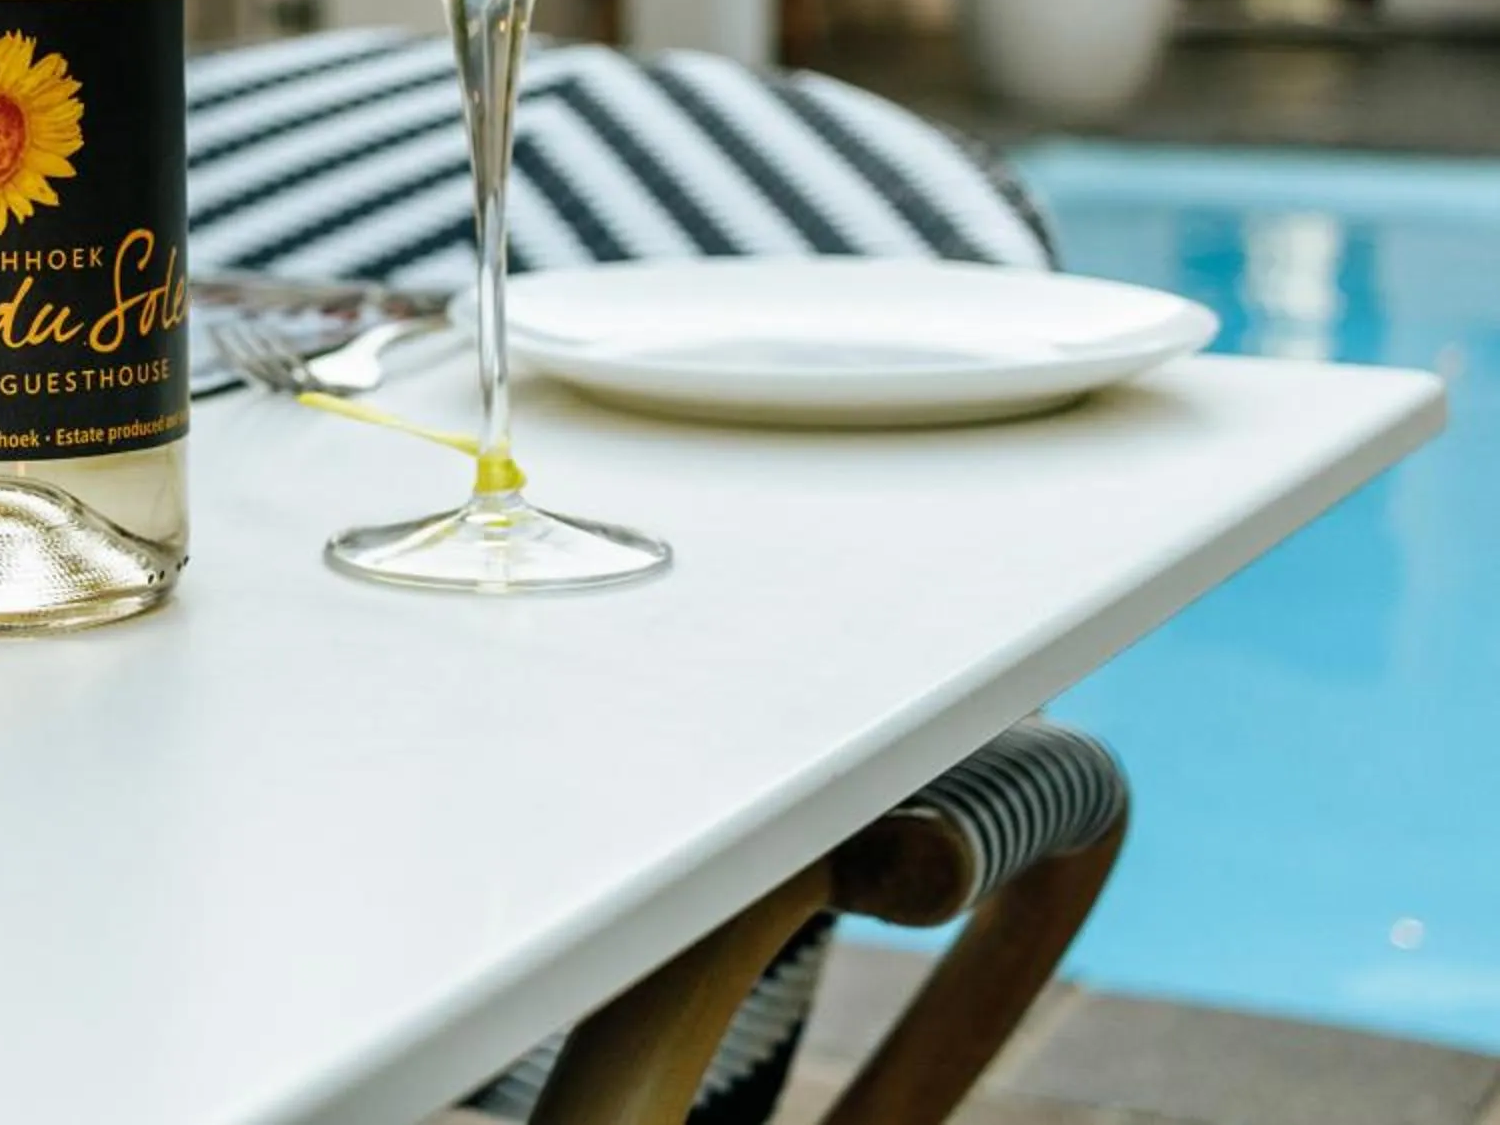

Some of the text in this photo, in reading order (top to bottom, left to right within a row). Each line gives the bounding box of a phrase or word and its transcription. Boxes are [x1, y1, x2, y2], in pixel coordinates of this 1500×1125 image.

[90, 229, 188, 352] Sole
[0, 358, 171, 396] GUESTHOUSE
[56, 427, 105, 446] Estate
